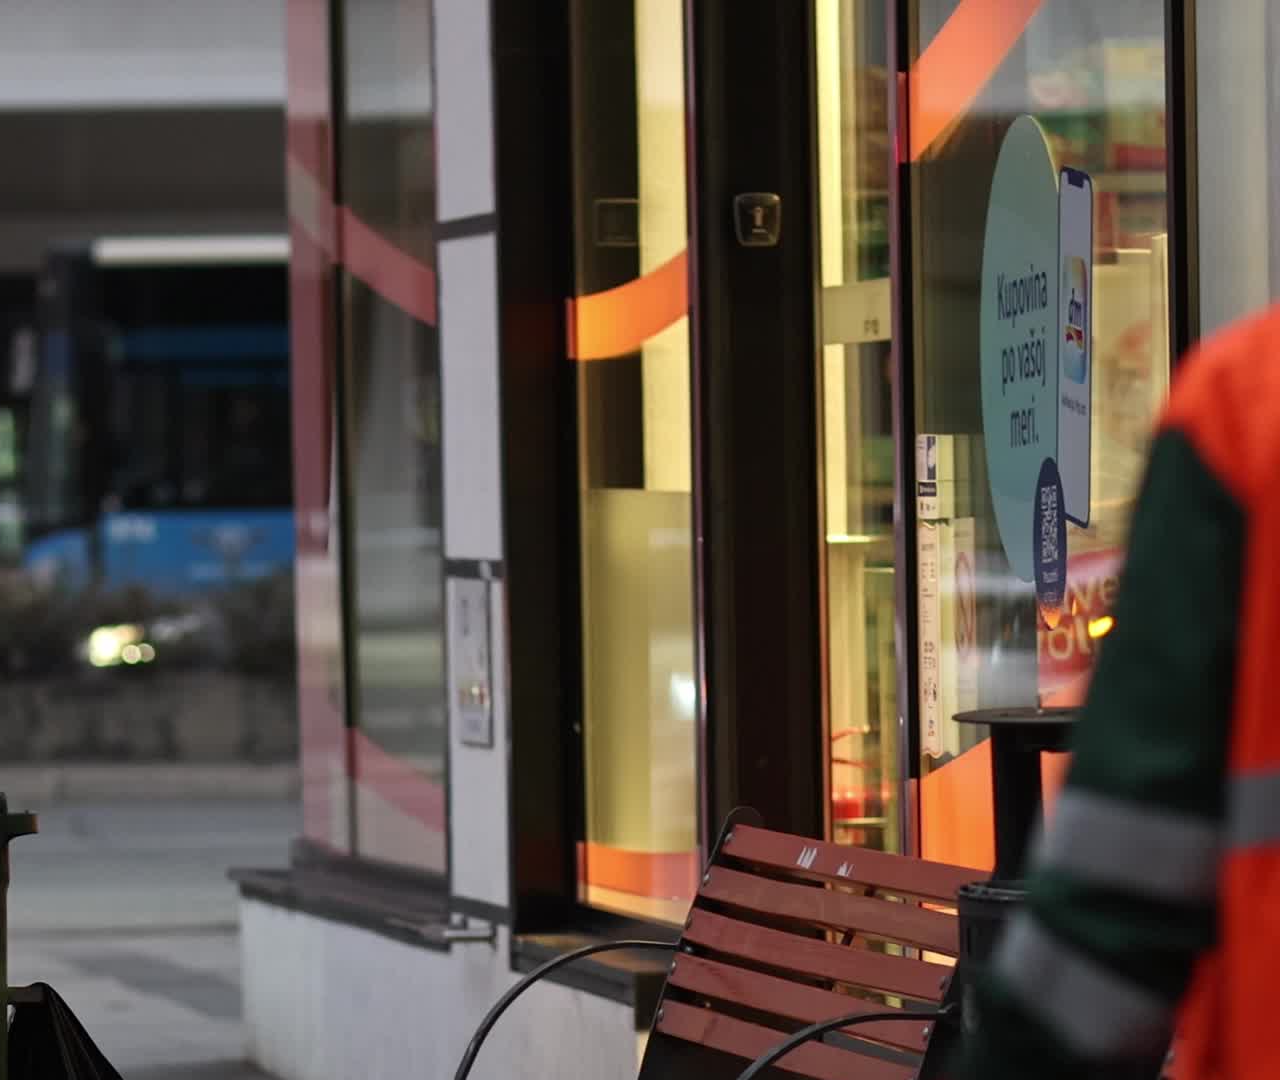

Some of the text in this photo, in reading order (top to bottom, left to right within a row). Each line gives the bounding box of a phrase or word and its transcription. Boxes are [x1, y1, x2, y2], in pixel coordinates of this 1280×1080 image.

[996, 264, 1048, 328] Kupovina
[1001, 327, 1047, 397] po vašoj
[1010, 394, 1039, 448] meri.
